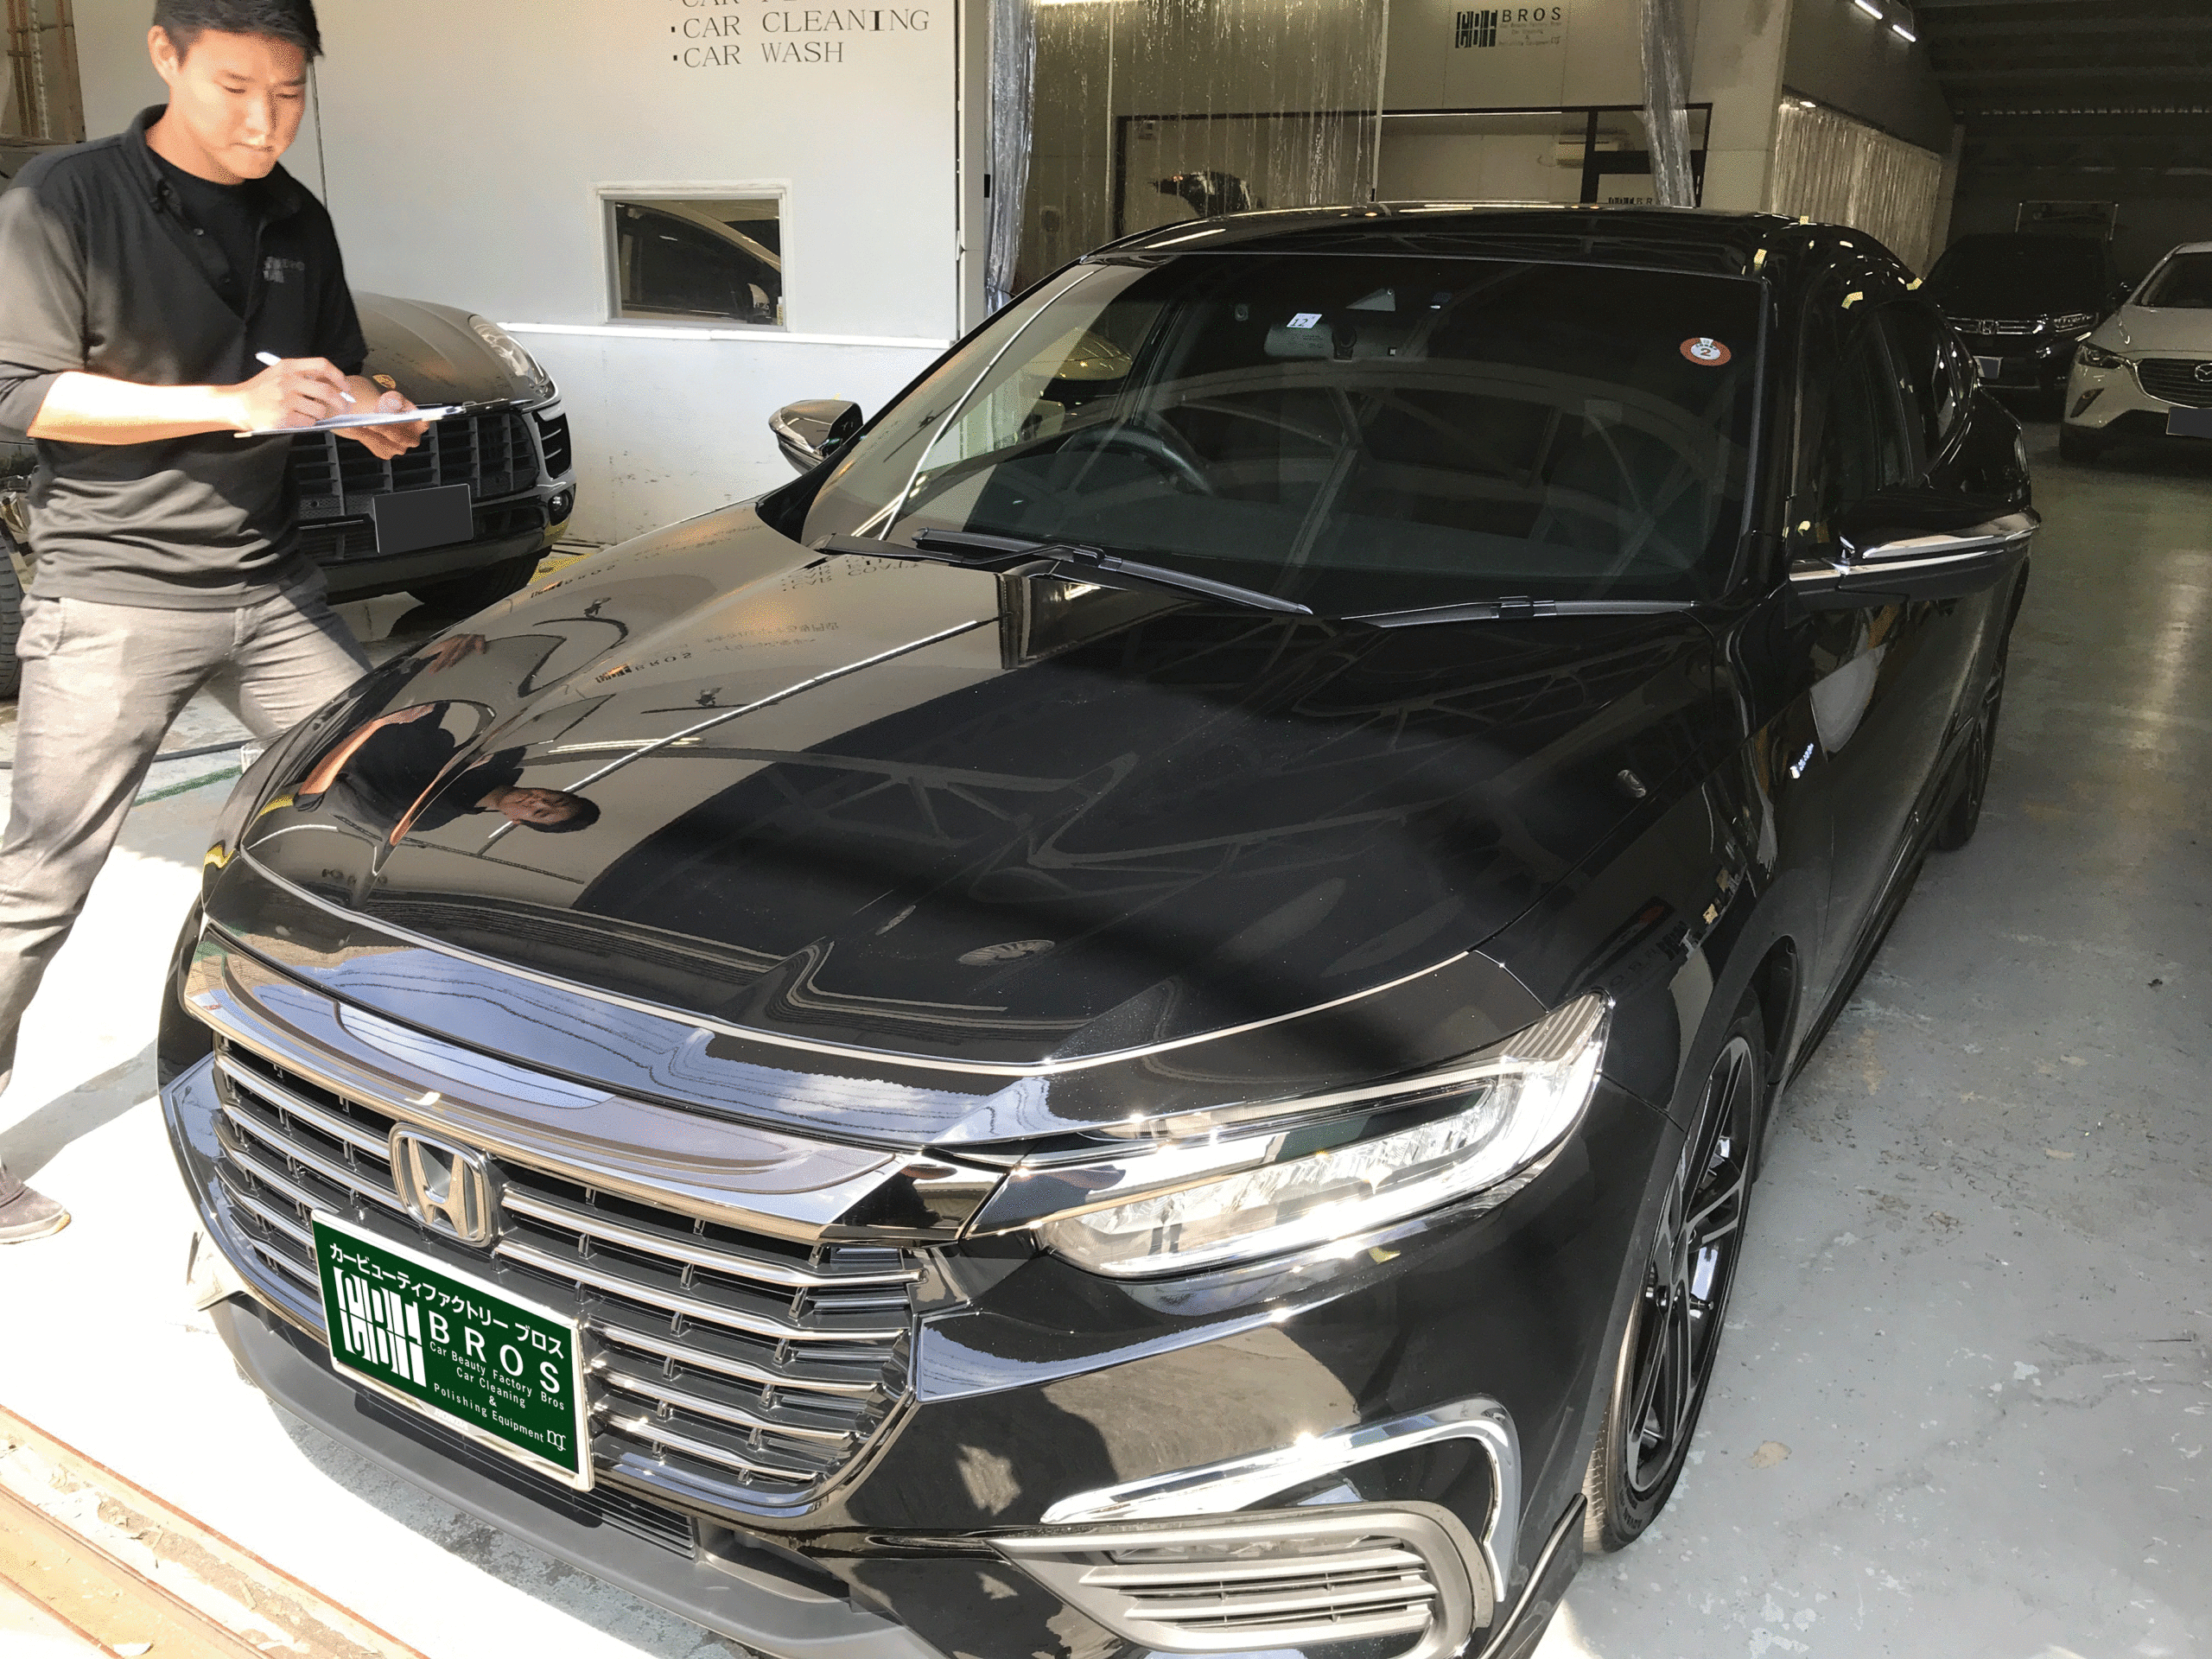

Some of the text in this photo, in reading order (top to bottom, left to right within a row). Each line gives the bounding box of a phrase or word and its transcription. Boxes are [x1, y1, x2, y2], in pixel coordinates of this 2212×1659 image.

[683, 10, 930, 39] CAR CLEANING
[1502, 7, 1561, 22] BROS
[683, 41, 844, 68] CAR WASH
[1700, 347, 1712, 357] 2
[329, 1243, 565, 1360] カービューティファクトリー ブロス
[429, 1310, 561, 1394] BROS
[429, 1341, 564, 1410] Car Beauty Factory Bros
[456, 1367, 525, 1408] Car Cleaning
[434, 1382, 544, 1443] Polishing Equipment
[489, 1395, 497, 1408] &
